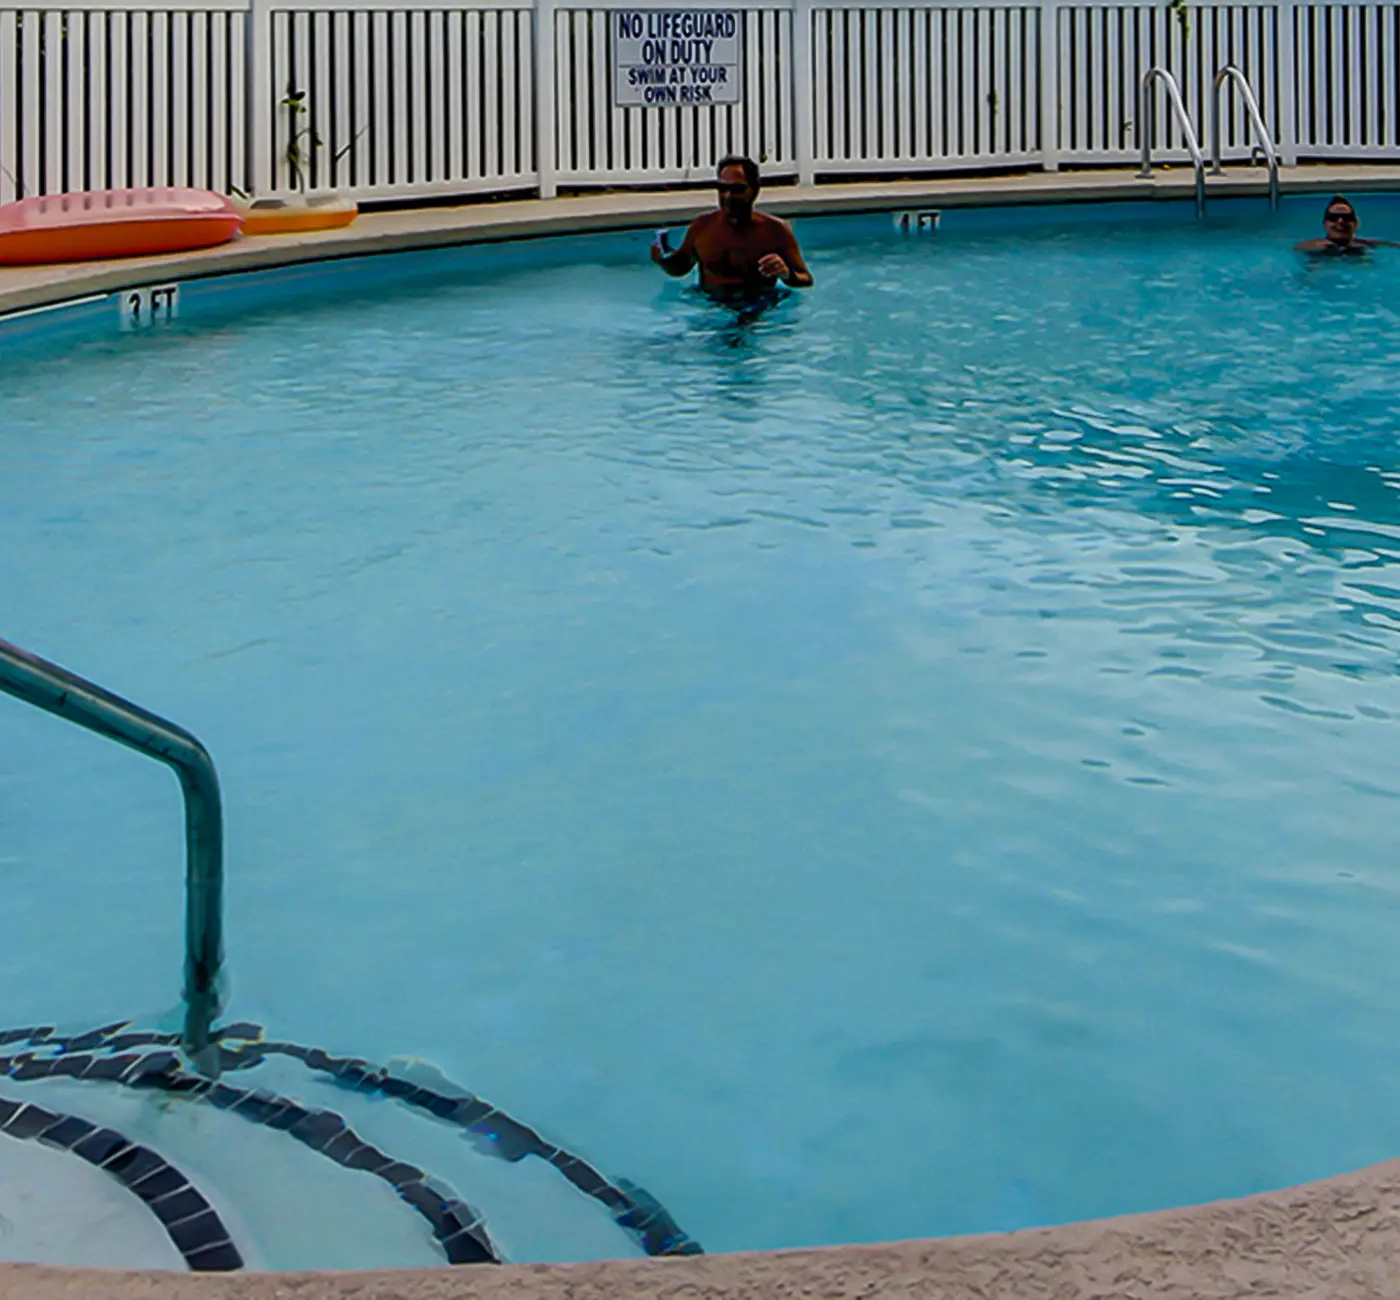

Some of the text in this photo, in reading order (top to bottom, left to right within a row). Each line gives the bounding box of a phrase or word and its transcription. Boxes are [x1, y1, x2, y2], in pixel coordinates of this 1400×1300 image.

[619, 13, 736, 38] NO LIFEGUARD
[642, 40, 713, 64] ON DUTY
[628, 66, 728, 85] SWIM AT YOUR
[644, 85, 712, 103] OWN RISK
[150, 286, 177, 325] FT
